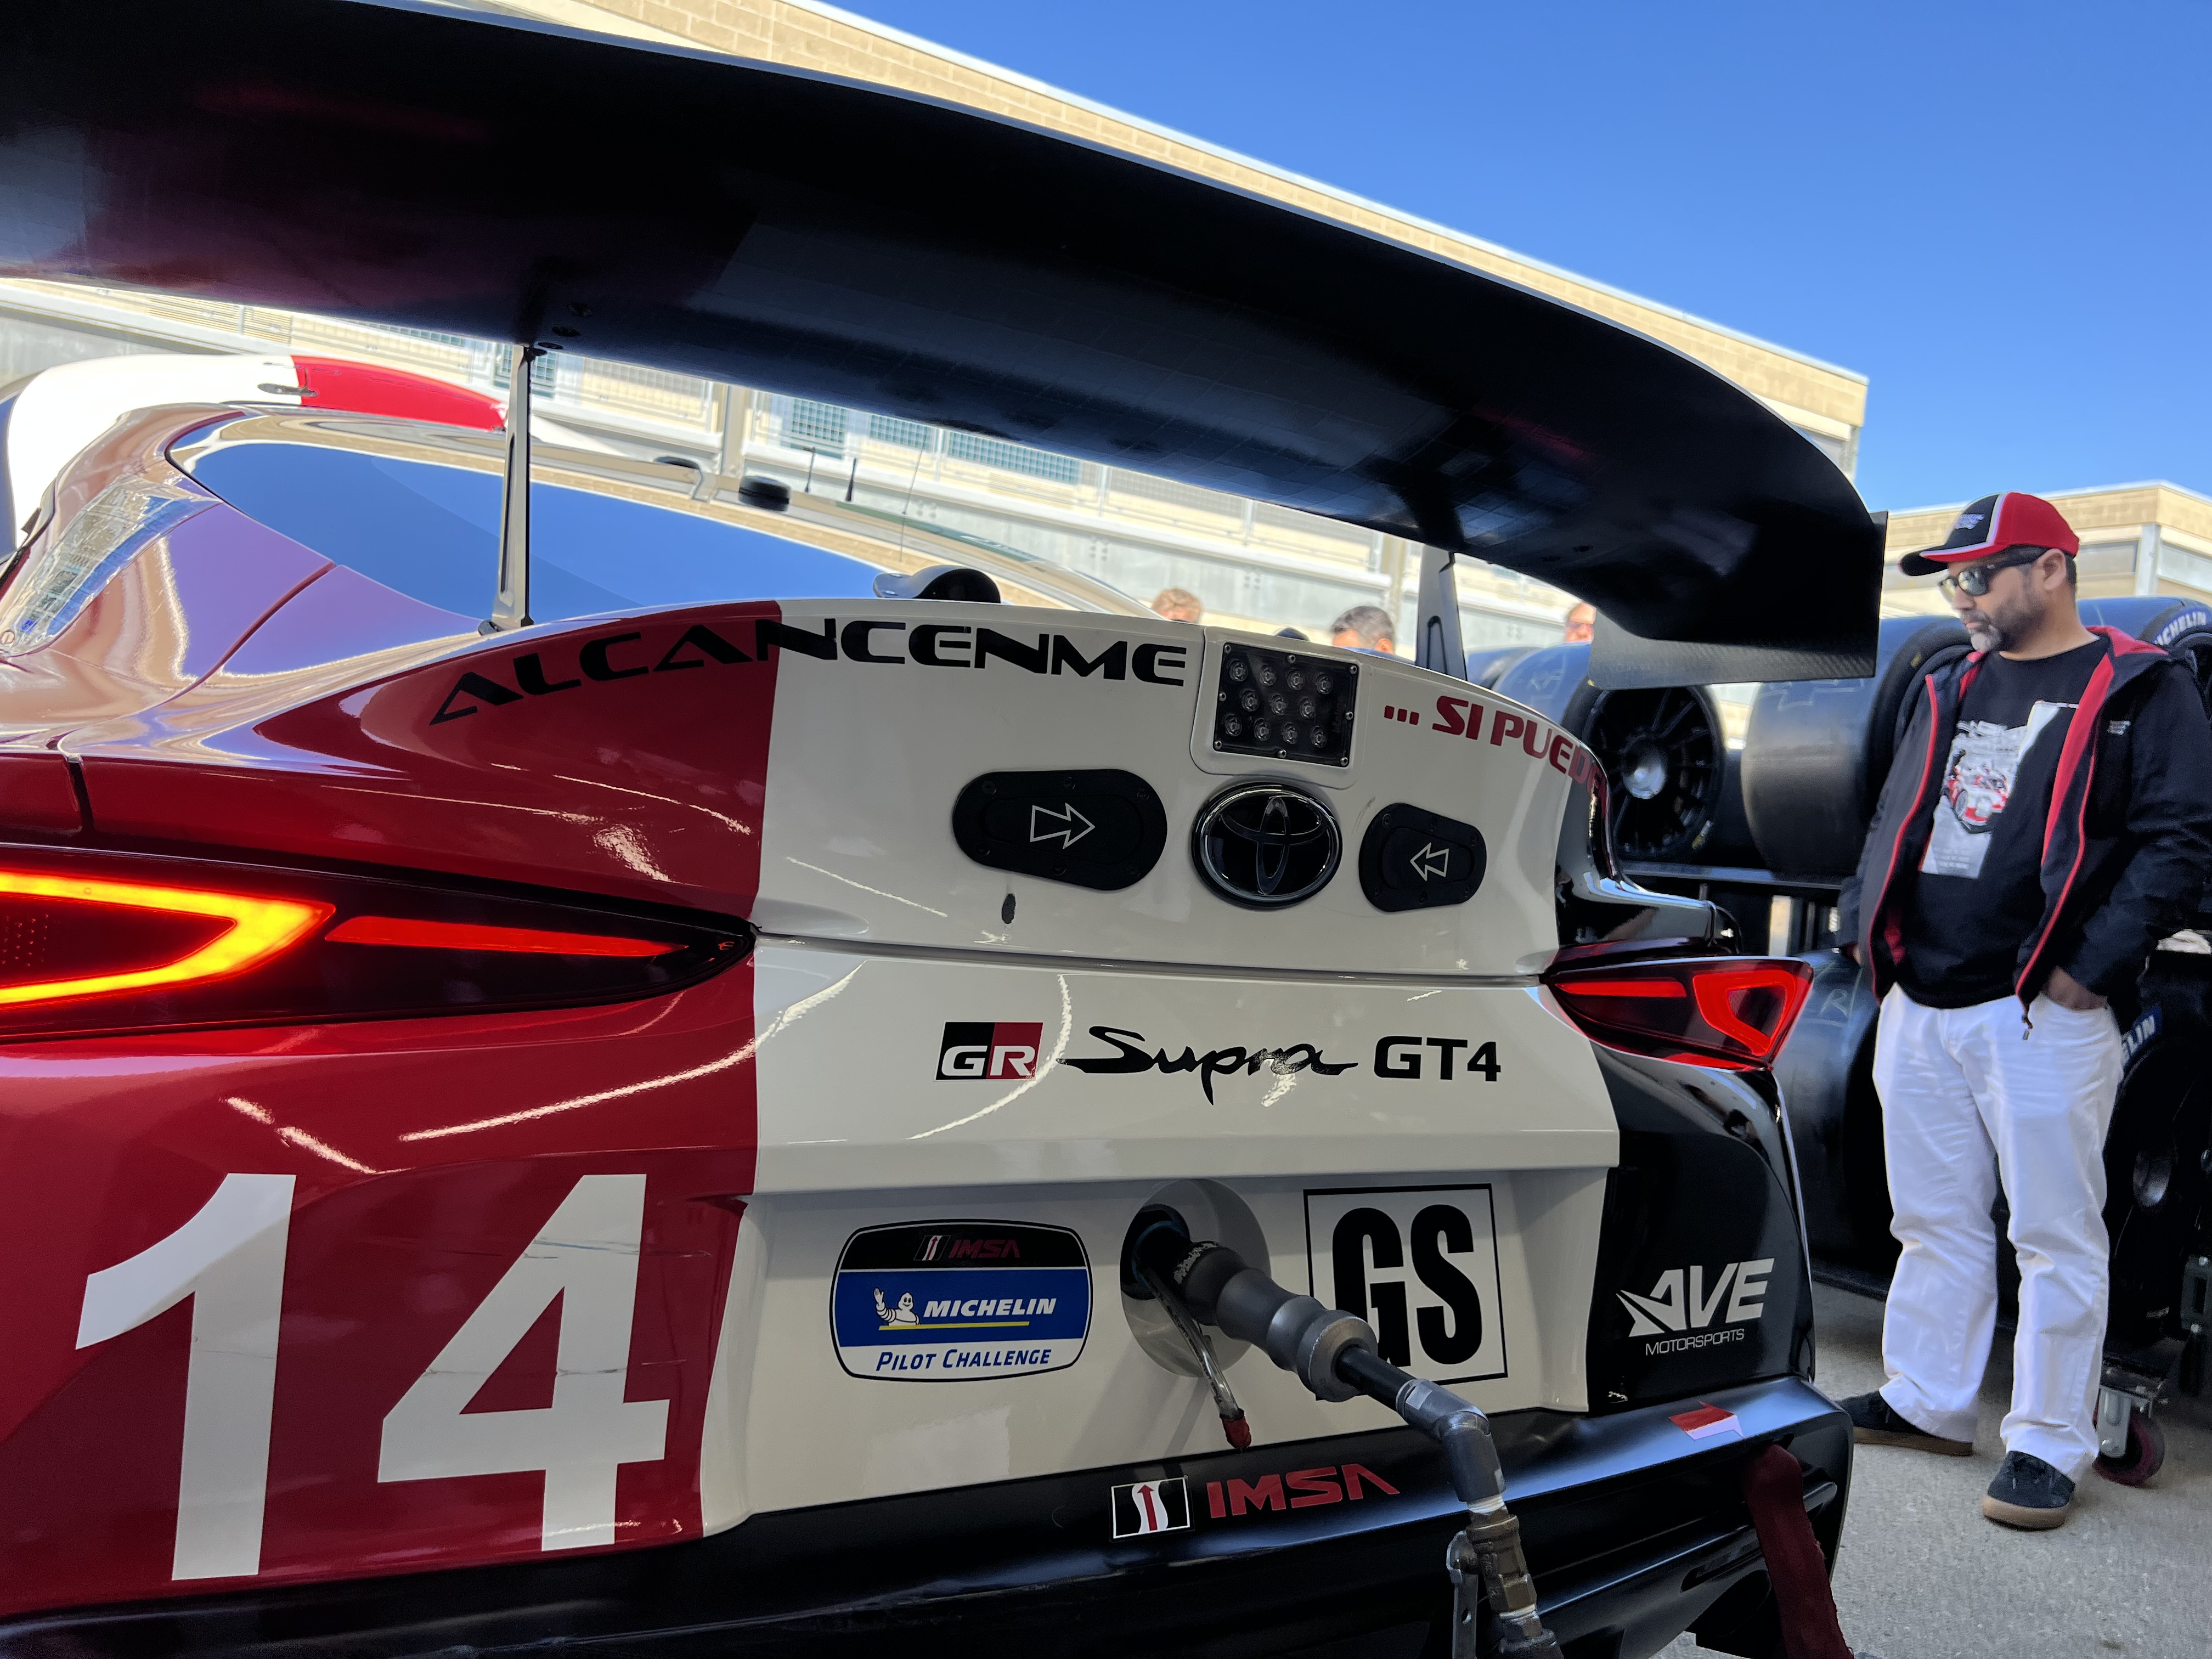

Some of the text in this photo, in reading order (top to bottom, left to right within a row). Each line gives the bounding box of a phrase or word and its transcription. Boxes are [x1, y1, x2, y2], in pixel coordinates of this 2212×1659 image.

[2153, 611, 2206, 645] ICHELIN
[428, 618, 1187, 726] ALCANCENME
[941, 1025, 1502, 1106] GR Supra GT4
[949, 1239, 1020, 1259] IMSA
[923, 1297, 1057, 1318] MICHELIN
[1332, 1204, 1483, 1368] GS
[1616, 1257, 1775, 1338] AVE
[876, 1348, 1052, 1372] PILOT CHALLENGE
[1645, 1328, 1745, 1356] MOTORSPORTS
[75, 1173, 670, 1581] 14
[1206, 1463, 1400, 1519] IMSA
